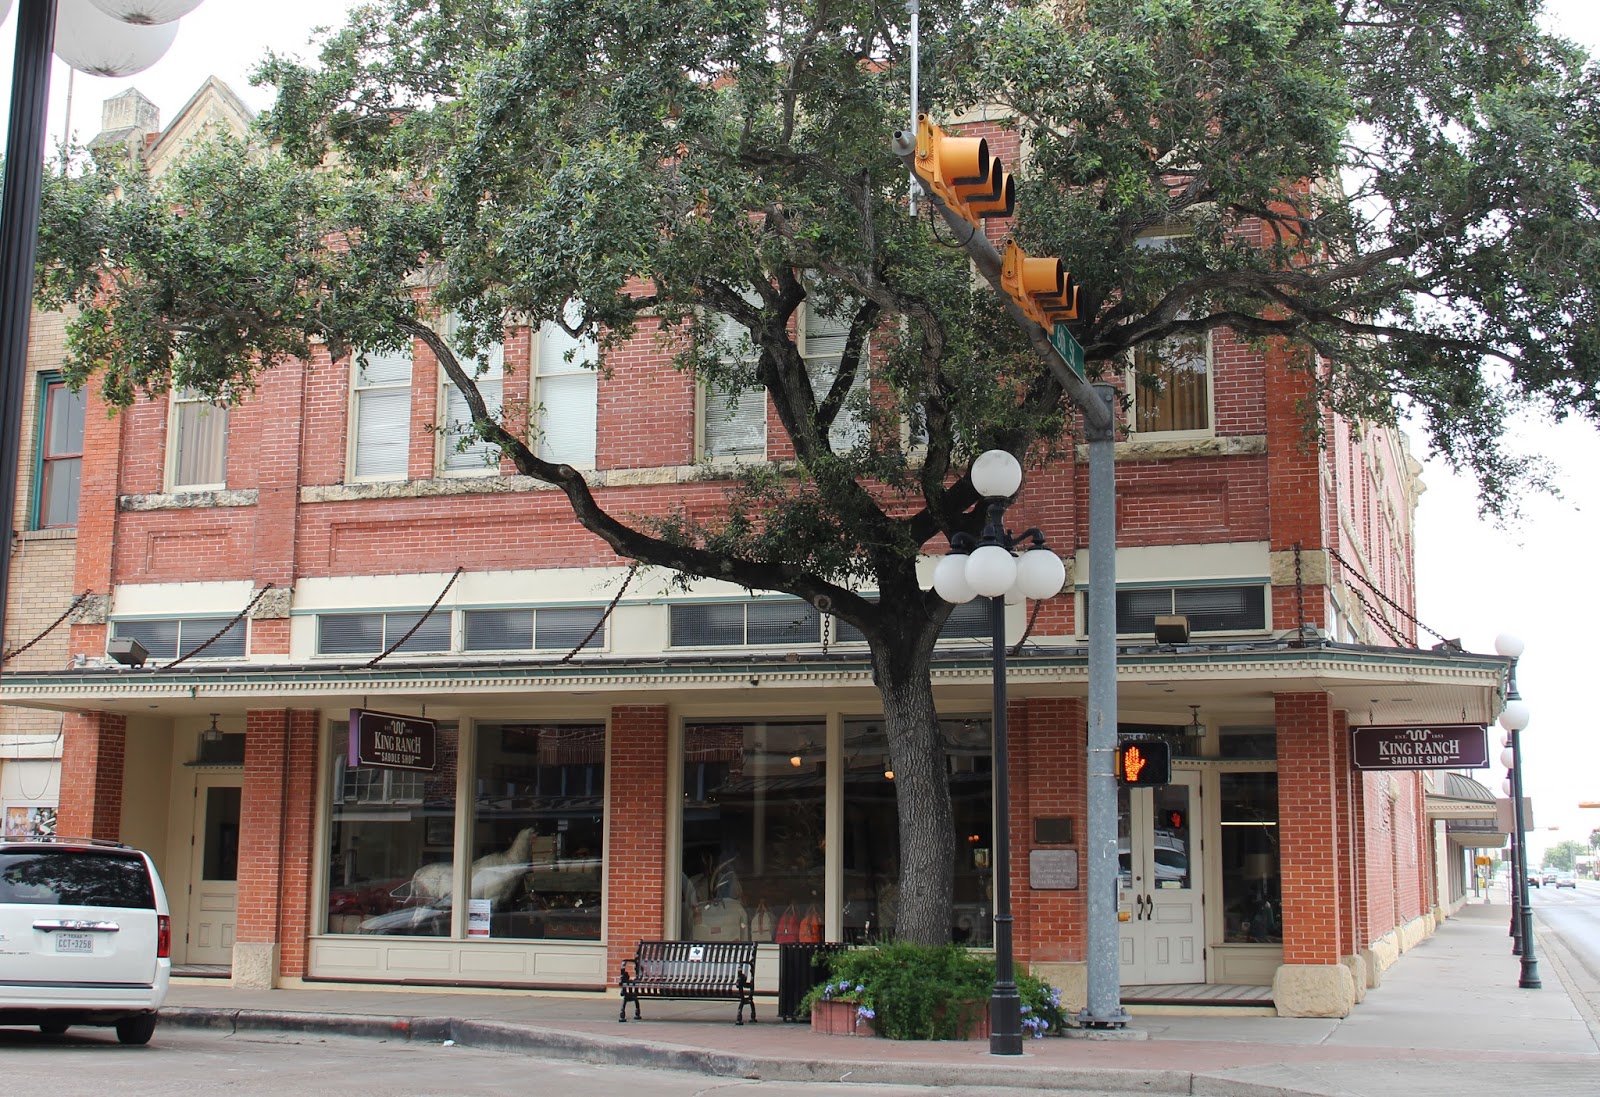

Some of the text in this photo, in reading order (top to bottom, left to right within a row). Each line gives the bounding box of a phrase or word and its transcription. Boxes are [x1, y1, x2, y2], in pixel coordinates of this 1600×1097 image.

[374, 731, 421, 754] KING RANCH
[1379, 739, 1459, 755] KING RANCH
[381, 751, 415, 764] SADDLE SHOP
[1391, 755, 1449, 765] SADDLE SHOP
